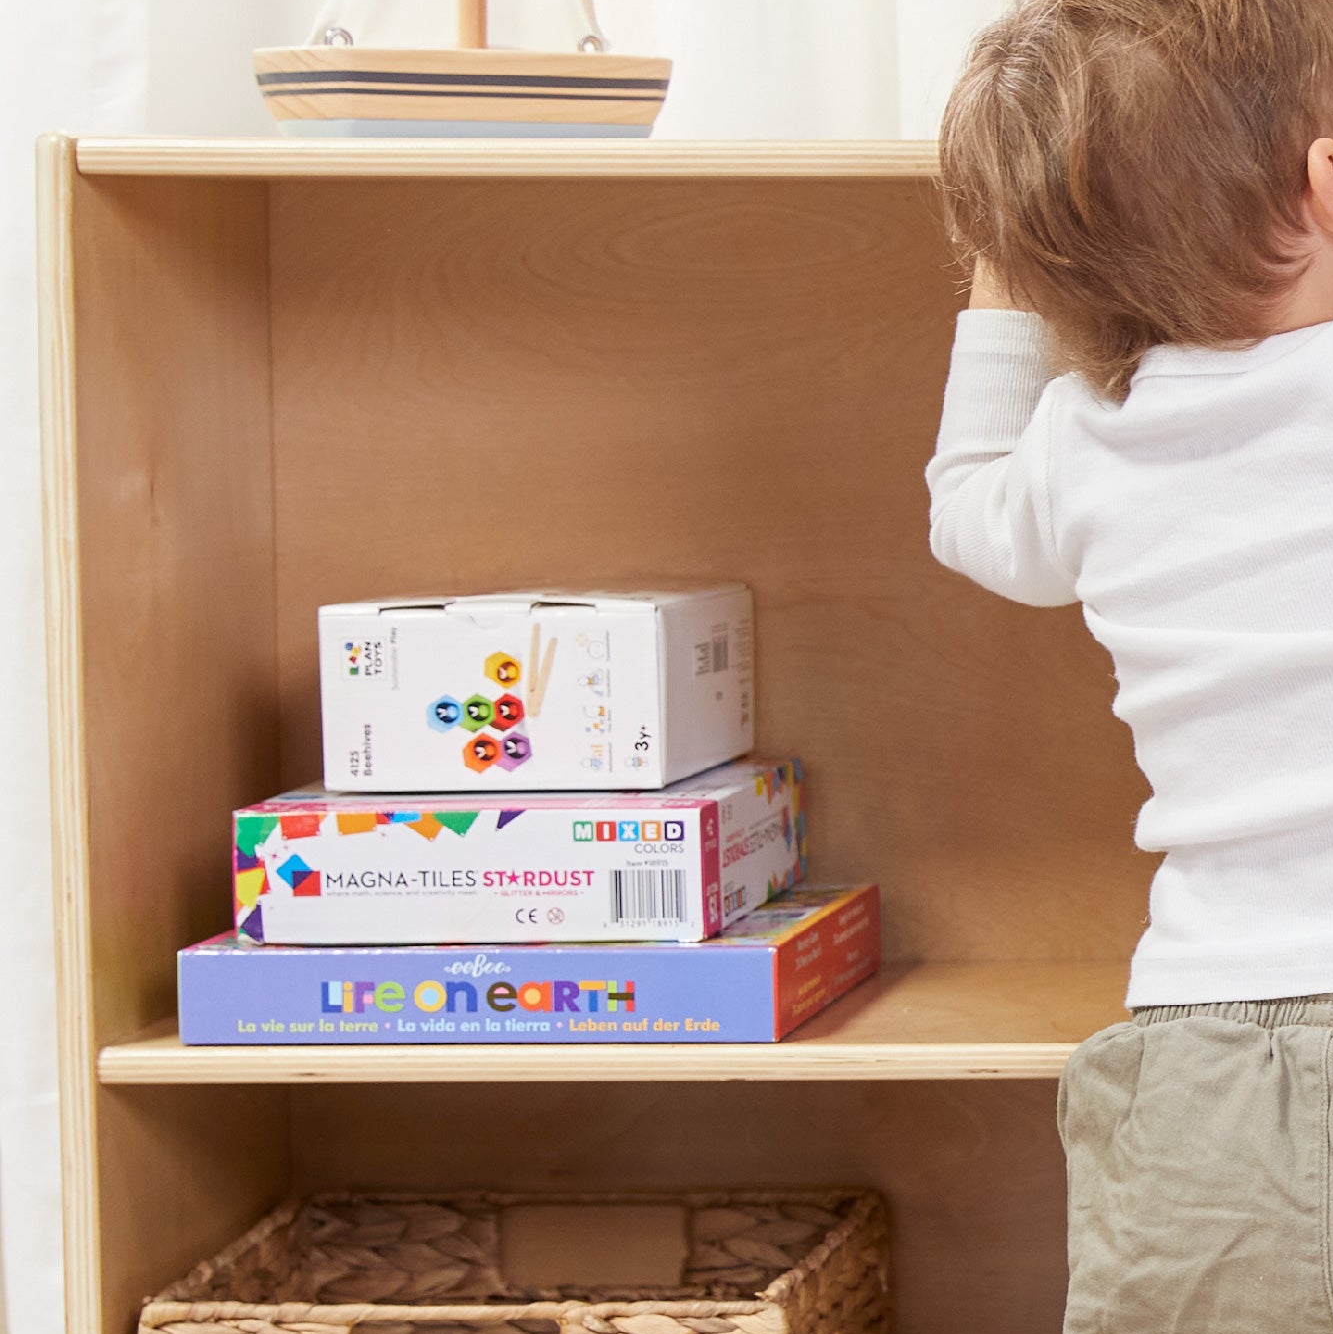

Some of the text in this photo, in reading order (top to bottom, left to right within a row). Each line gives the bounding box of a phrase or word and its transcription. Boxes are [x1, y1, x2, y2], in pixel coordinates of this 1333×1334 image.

[364, 641, 372, 676] PLAN
[374, 642, 382, 675] TOYS
[635, 726, 651, 751] 3y+
[363, 724, 372, 776] Beehives
[350, 750, 359, 776] 4125
[574, 821, 684, 841] MIXED
[634, 843, 684, 854] COLORS
[326, 870, 477, 888] MAGNA-TILES
[414, 980, 478, 1013] on
[237, 1019, 378, 1033] La vie sur la terre
[397, 1018, 551, 1033] La vida en la tierra
[568, 1018, 720, 1032] Leben auf der Erde
